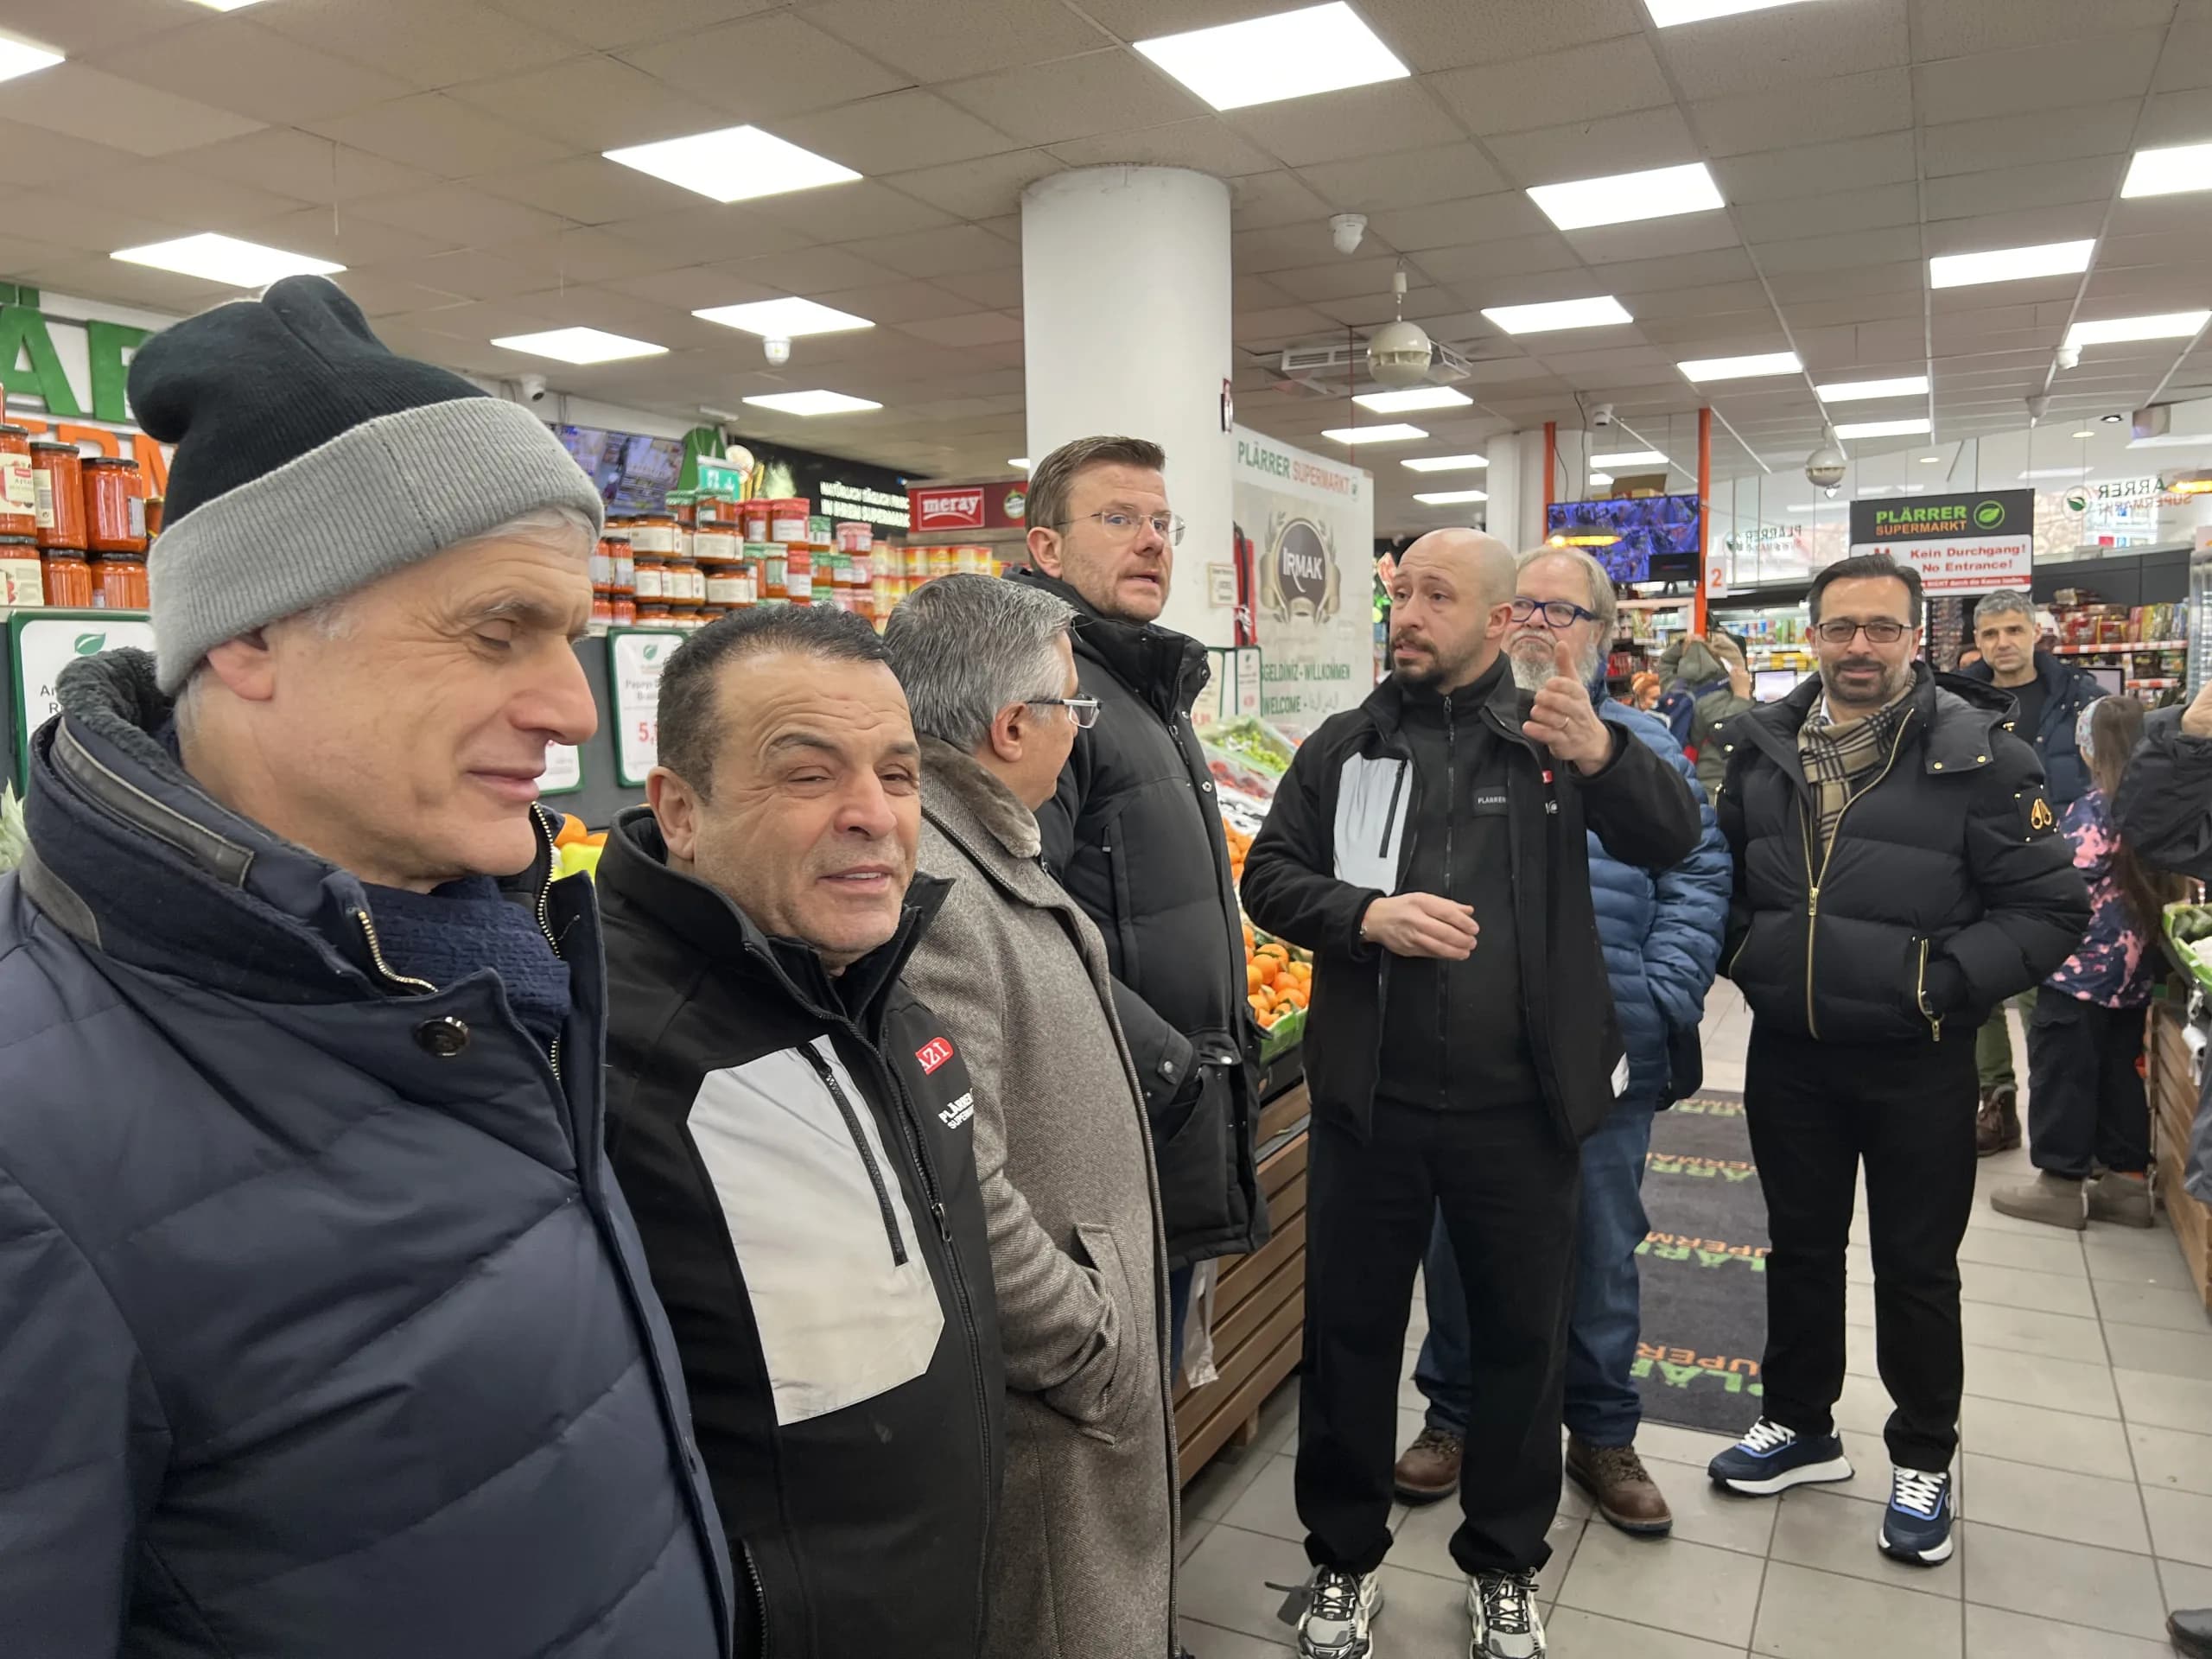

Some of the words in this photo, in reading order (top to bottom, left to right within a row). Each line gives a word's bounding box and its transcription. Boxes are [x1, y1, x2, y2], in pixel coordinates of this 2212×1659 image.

[1237, 441, 1290, 480] PLÄRRER
[1292, 461, 1350, 494] SUPERMARKT
[923, 495, 980, 516] meray
[1876, 505, 1967, 524] PLÄRRER
[1875, 519, 1967, 536] SUPERMARKT
[1910, 549, 1942, 560] Kein
[1947, 543, 2026, 557] Durchgang!
[1923, 564, 1940, 573] No
[1946, 559, 2012, 571] Entrance!
[1712, 568, 1722, 588] 2
[1304, 663, 1350, 681] WILLKOMMEN
[1262, 696, 1300, 715] WELCOME
